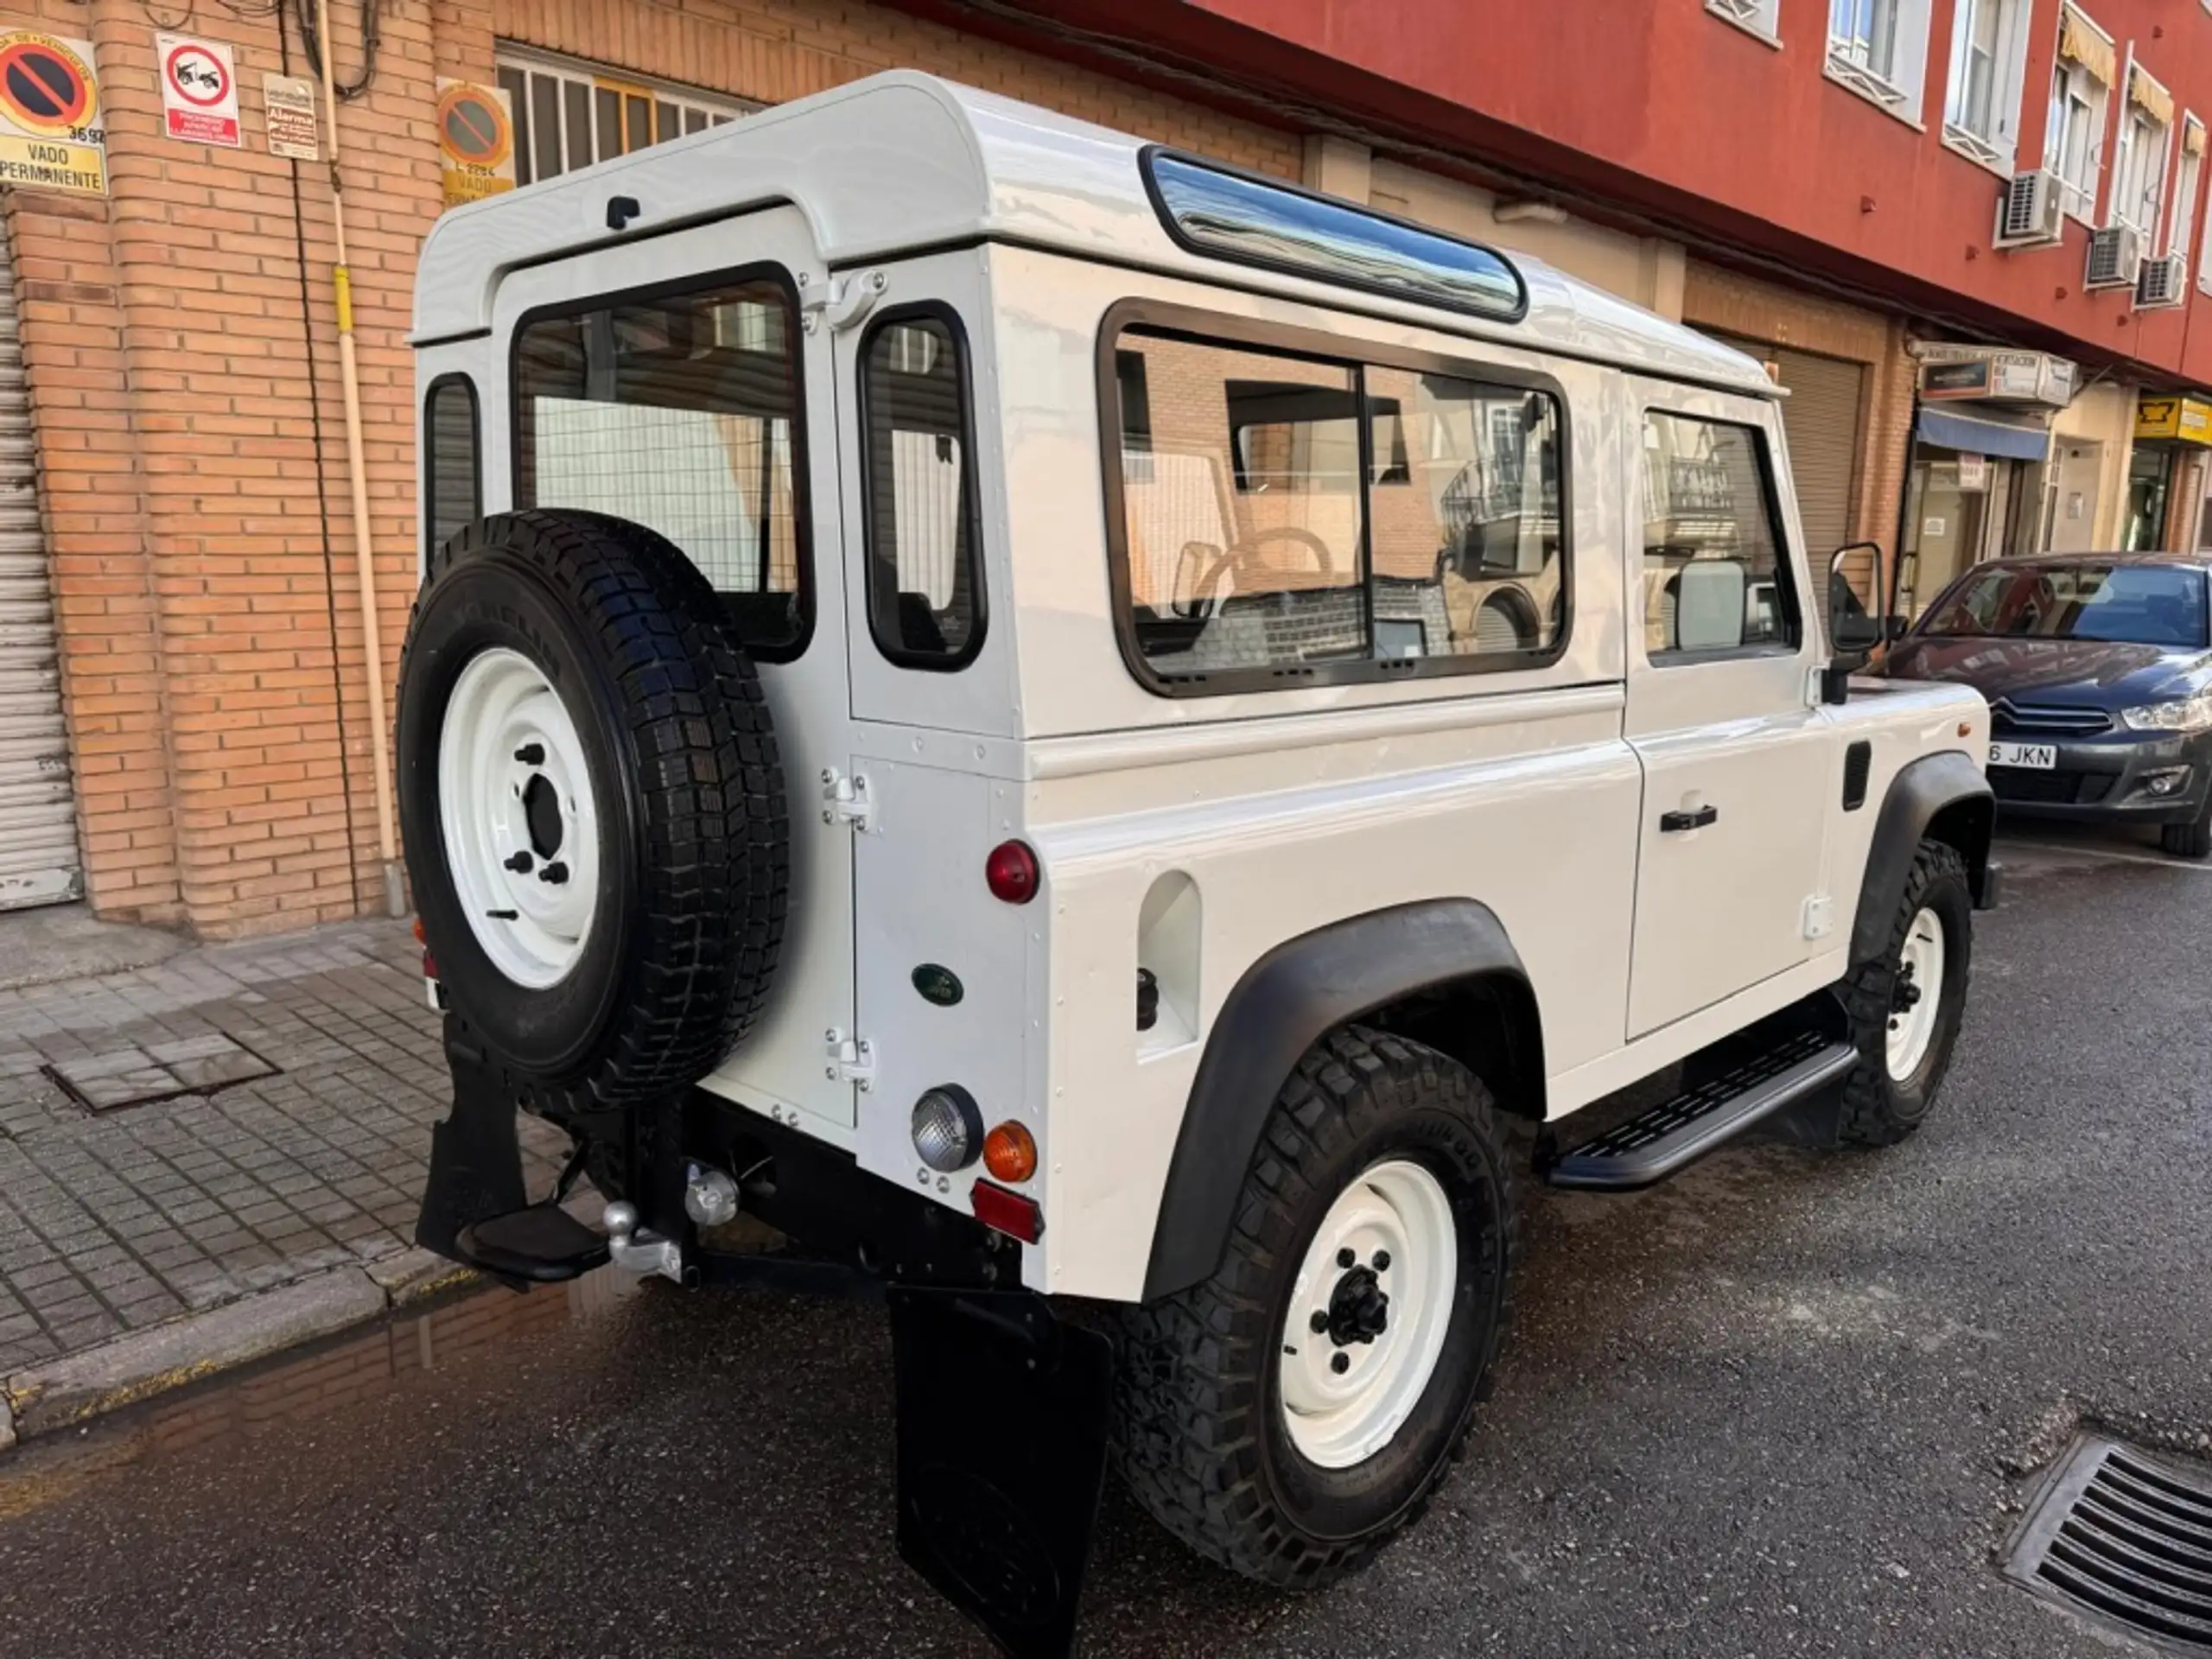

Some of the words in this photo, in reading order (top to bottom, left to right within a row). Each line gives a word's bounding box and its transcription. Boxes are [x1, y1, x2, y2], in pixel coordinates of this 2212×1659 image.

[28, 143, 68, 165] VADO
[0, 160, 100, 189] PERMANENTE
[459, 175, 492, 194] VADO
[2009, 747, 2051, 766] JKN
